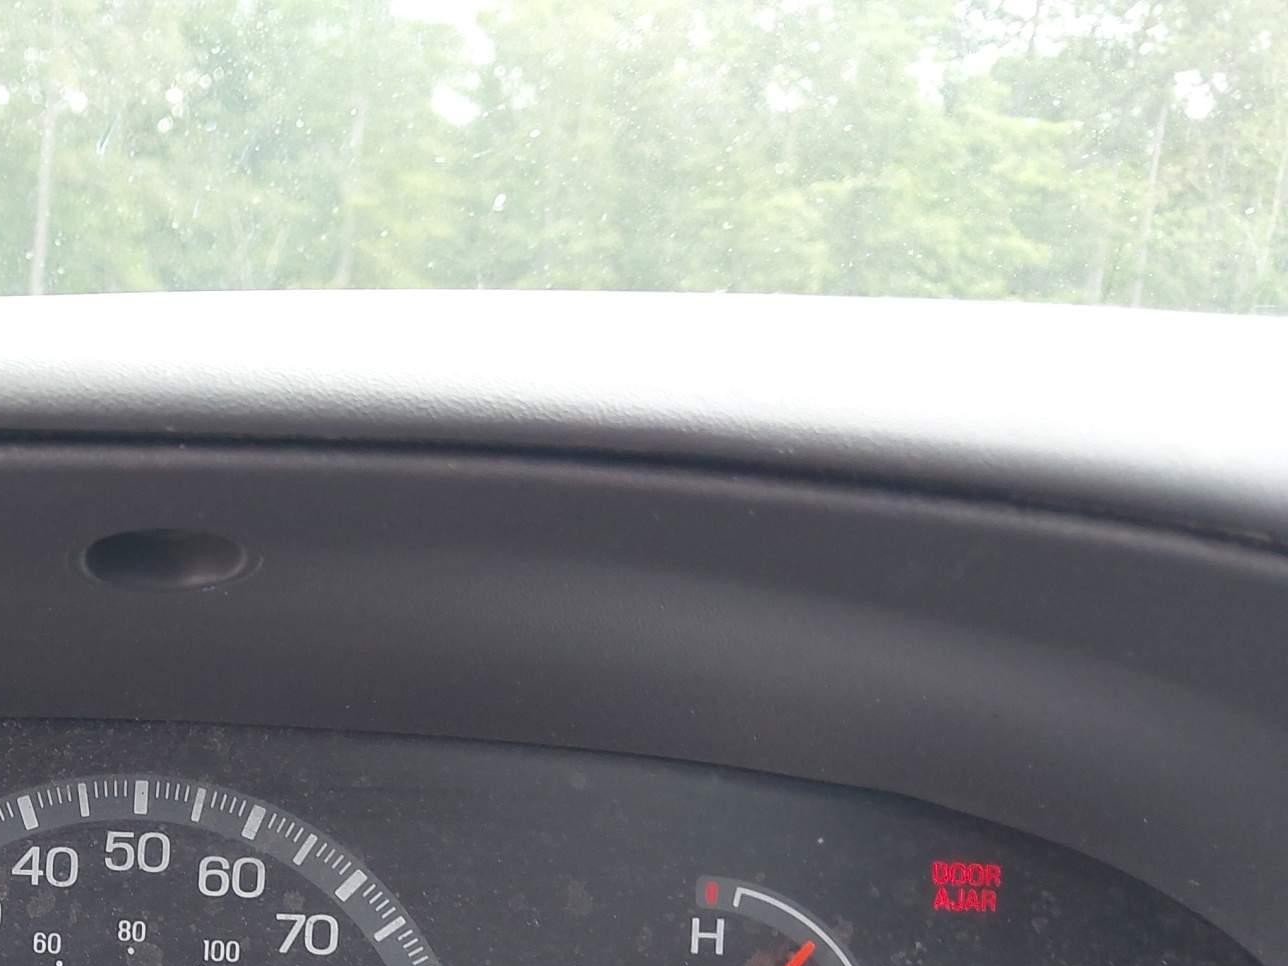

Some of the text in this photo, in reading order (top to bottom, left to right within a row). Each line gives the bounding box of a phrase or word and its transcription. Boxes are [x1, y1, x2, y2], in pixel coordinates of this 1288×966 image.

[12, 846, 79, 888] 40
[104, 831, 171, 873] 50
[197, 856, 267, 898] 60
[933, 861, 1001, 887] DOOR
[934, 887, 997, 912] AJAR
[32, 932, 62, 955] 60
[117, 920, 146, 943] 80
[275, 913, 340, 955] 70
[690, 917, 724, 955] H
[202, 940, 241, 963] 100
